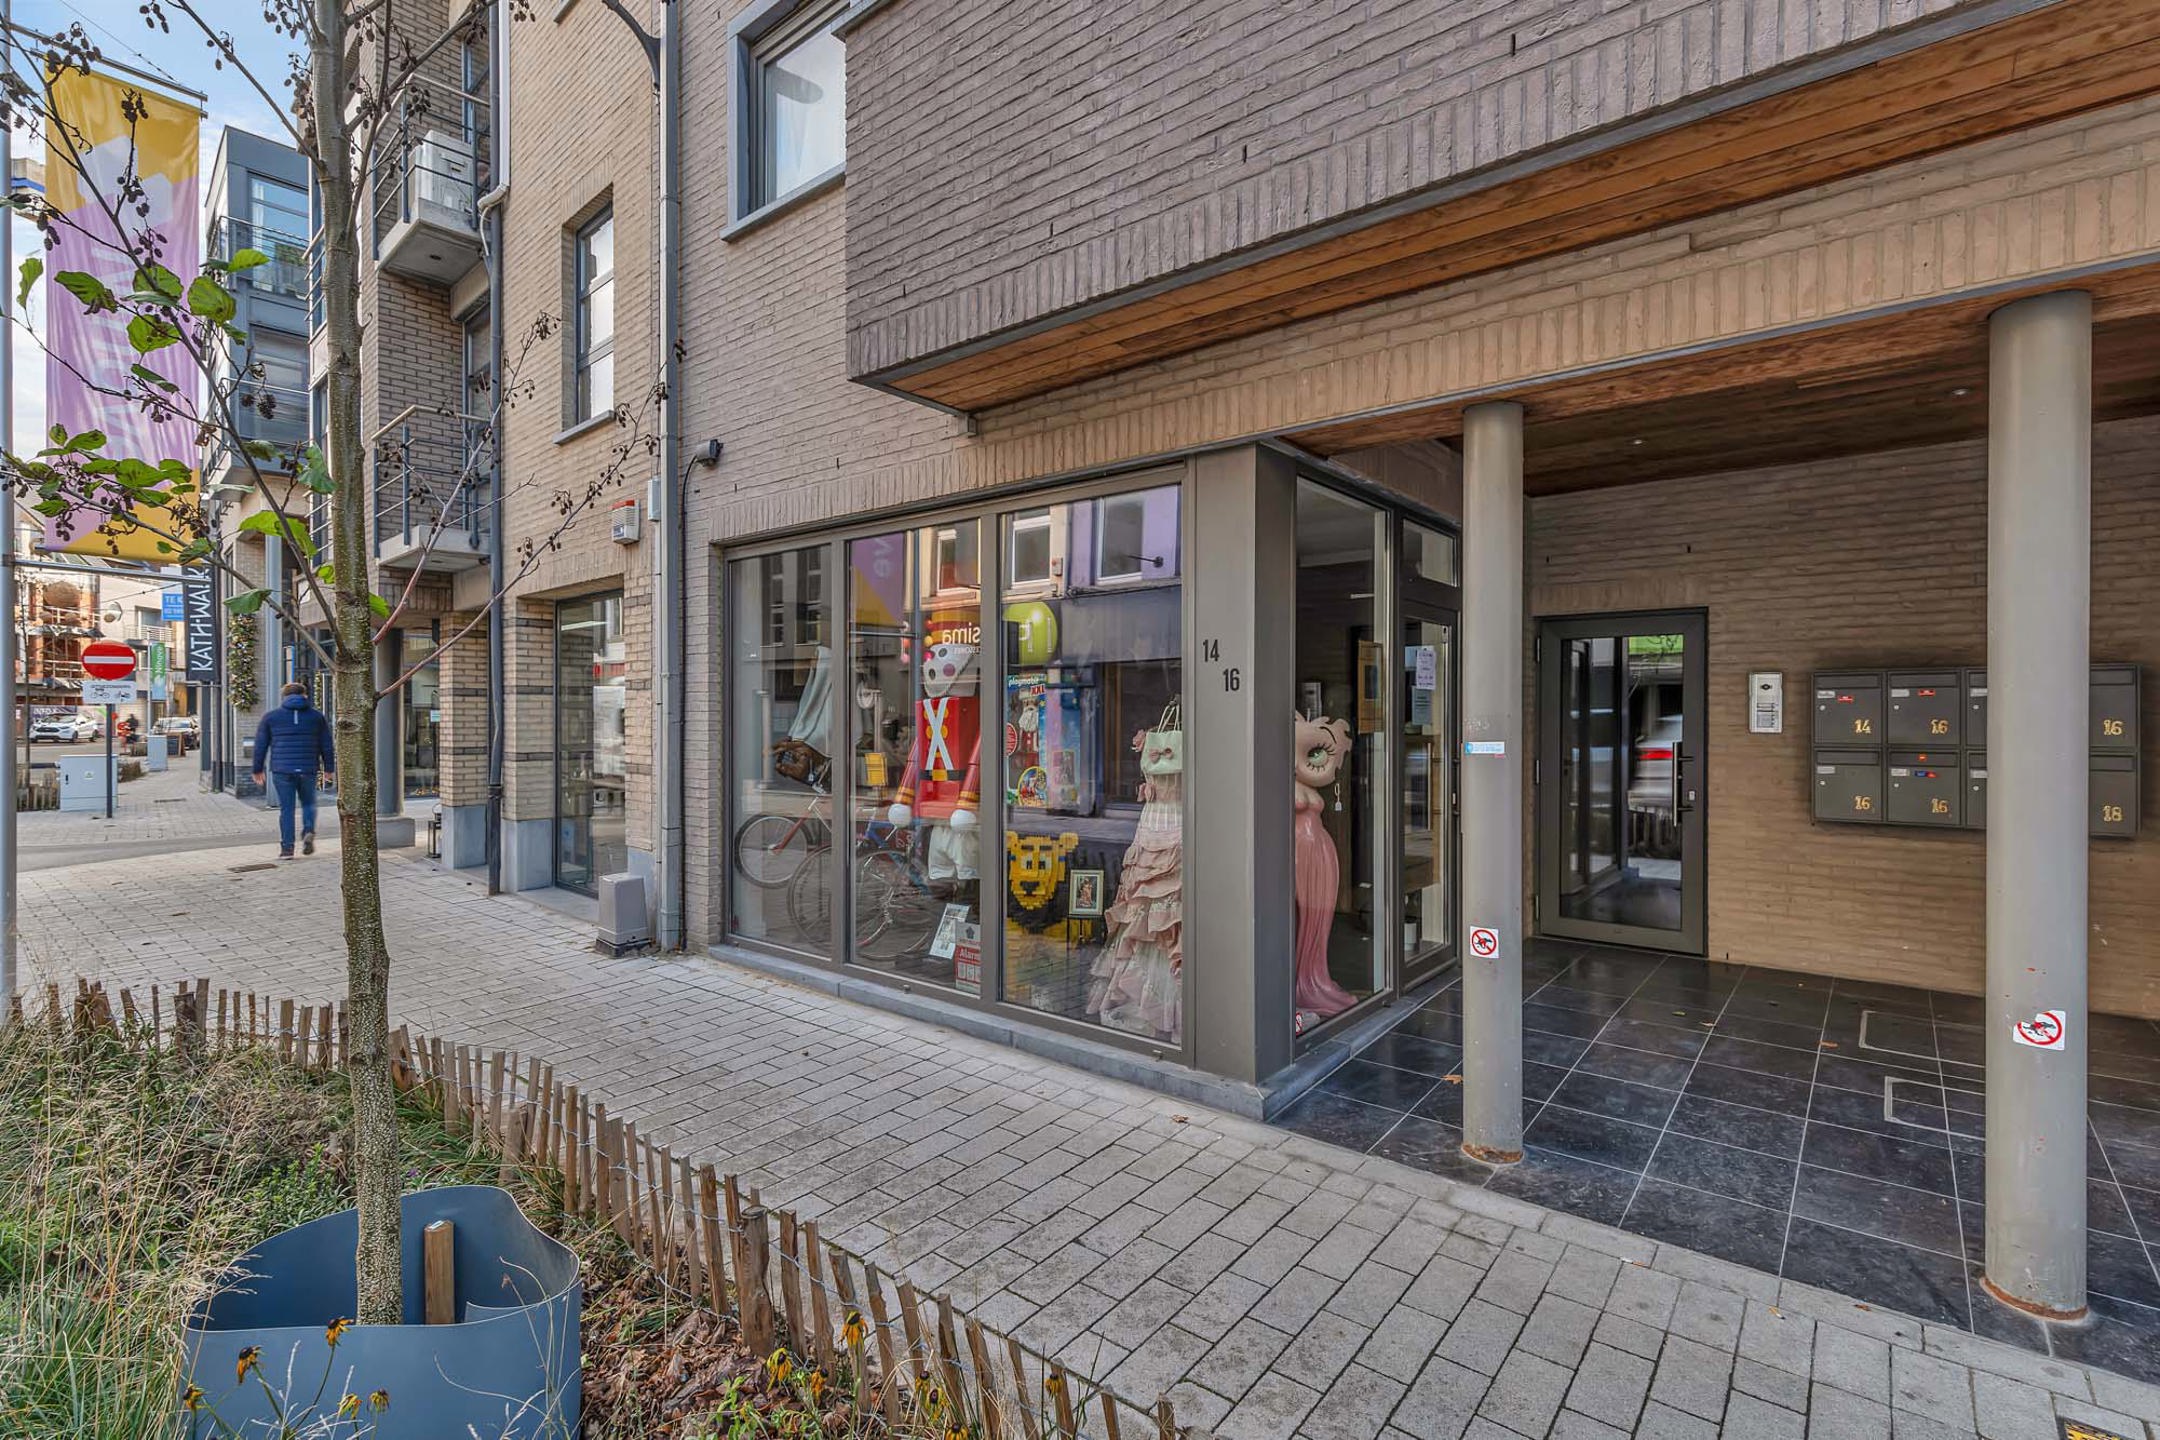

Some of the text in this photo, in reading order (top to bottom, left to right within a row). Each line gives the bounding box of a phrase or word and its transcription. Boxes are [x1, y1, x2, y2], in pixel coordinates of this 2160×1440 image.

[1203, 639, 1220, 662] 14
[1223, 668, 1240, 692] 16
[1031, 684, 1046, 696] XXL
[1854, 719, 1872, 734] 14
[1930, 719, 1949, 734] 16
[2103, 719, 2123, 735] 16
[1855, 795, 1871, 810] 16
[1931, 797, 1948, 813] 16
[2102, 805, 2122, 821] 18
